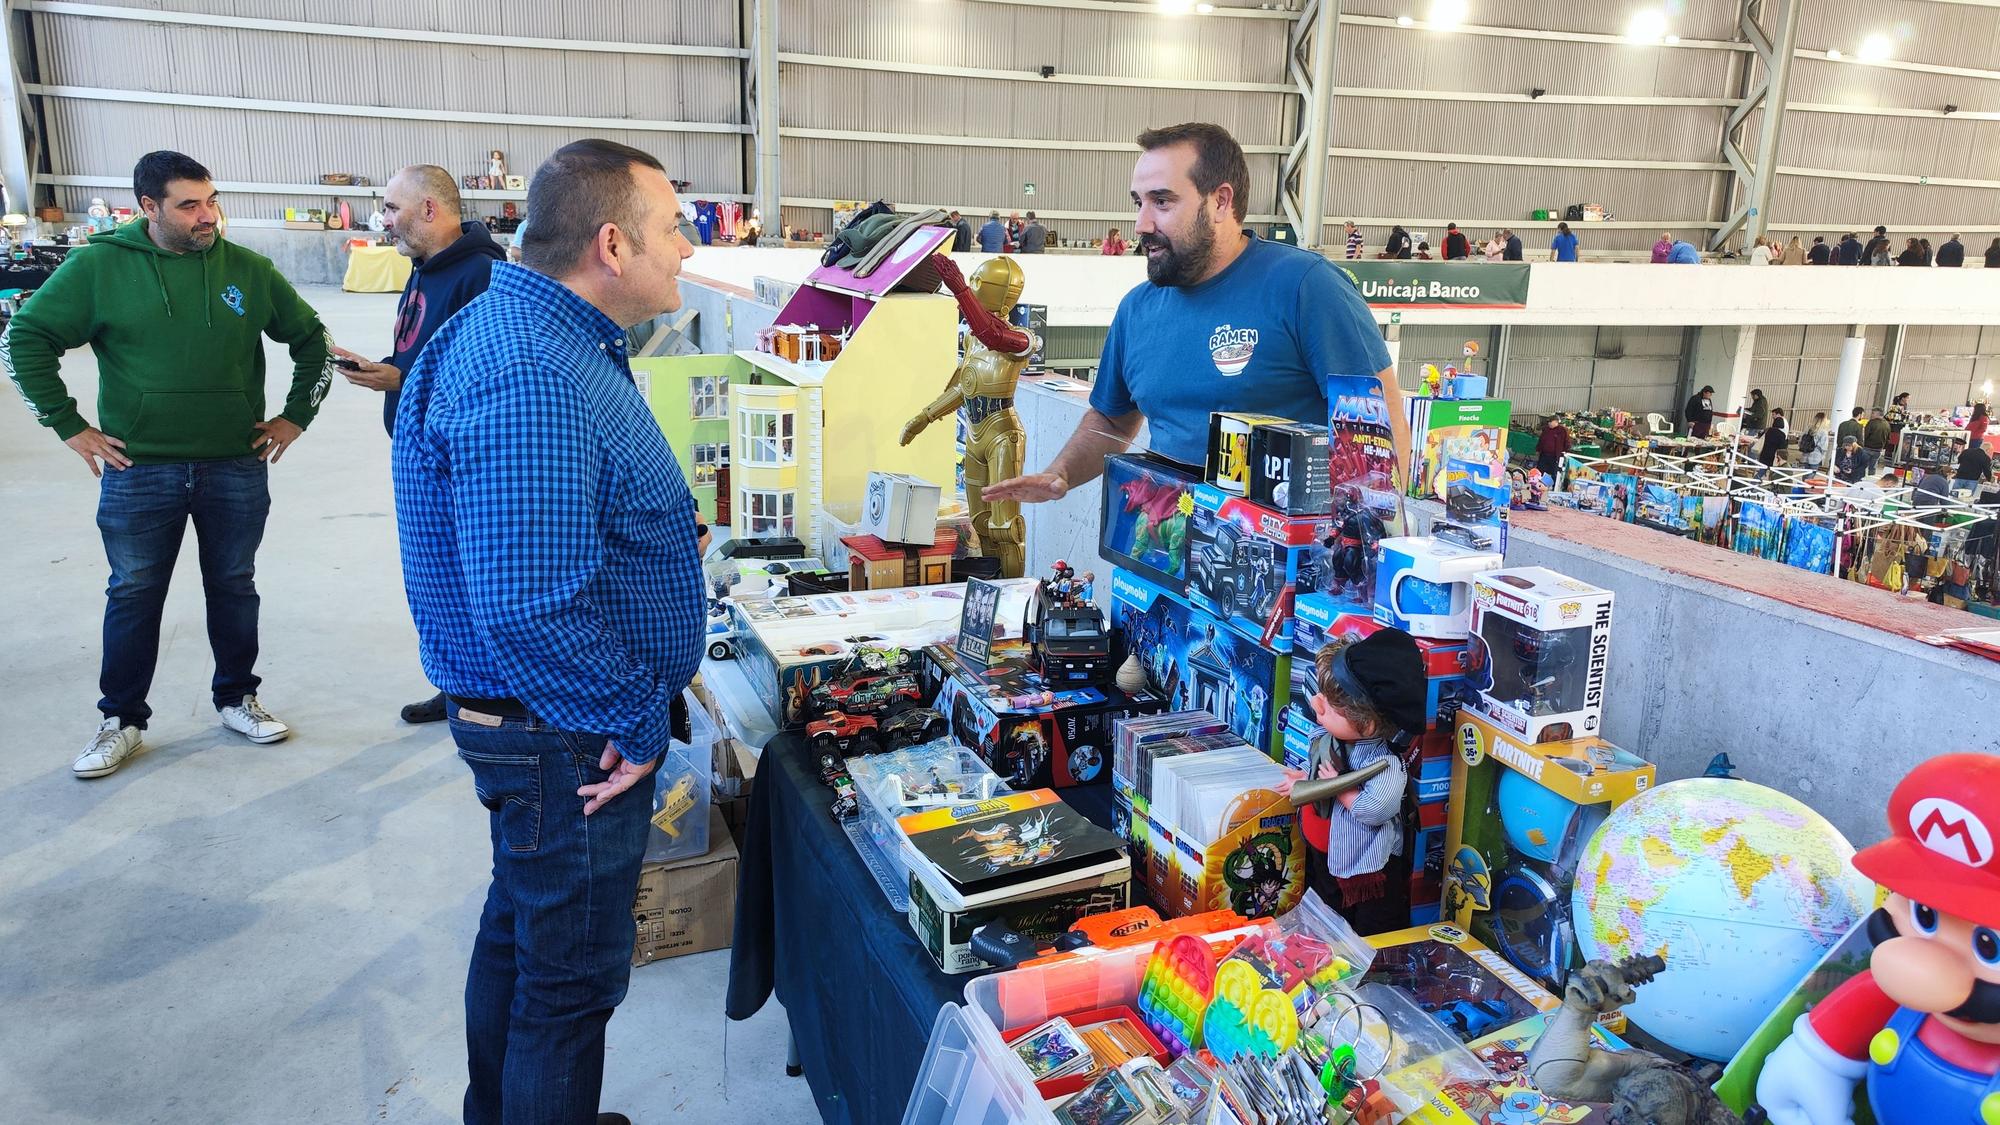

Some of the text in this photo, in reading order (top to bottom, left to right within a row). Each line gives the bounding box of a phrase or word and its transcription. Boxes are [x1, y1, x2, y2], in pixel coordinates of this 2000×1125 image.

[1362, 279, 1480, 302] Unicaja Banco
[1209, 329, 1259, 351] RAMEN
[1363, 444, 1391, 459] HE-MAN
[1261, 514, 1285, 531] CITY
[1263, 526, 1288, 542] ACTION
[1113, 576, 1148, 602] playmobil
[1295, 599, 1329, 621] playmobil
[1496, 593, 1525, 614] FORTNITE
[1525, 603, 1538, 619] 618
[1584, 600, 1612, 730] THE SCIENTIST 618
[1491, 702, 1501, 714] THE
[1501, 708, 1527, 728] SCIENTIST
[1067, 716, 1076, 740] 70750
[1463, 727, 1474, 739] 14
[1285, 732, 1309, 752] playm
[1492, 735, 1545, 781] FORTNITE
[1431, 782, 1450, 792] 7100
[951, 804, 980, 818] SAINT
[1917, 807, 1982, 863] M
[668, 906, 693, 915] COLOR:
[1112, 919, 1149, 937] NERF
[1441, 925, 1462, 937] 22
[1600, 1010, 1622, 1021] PACK
